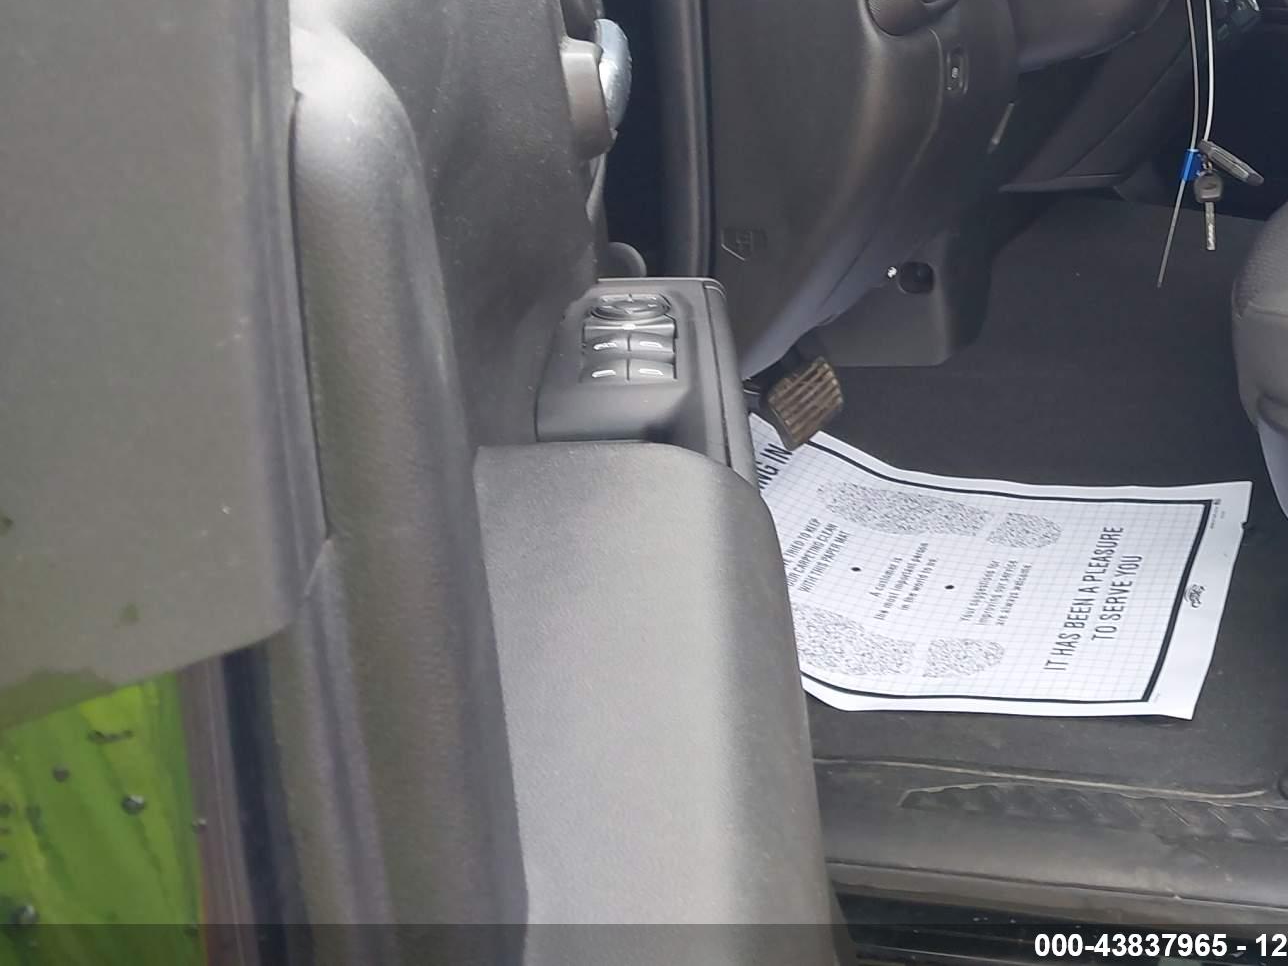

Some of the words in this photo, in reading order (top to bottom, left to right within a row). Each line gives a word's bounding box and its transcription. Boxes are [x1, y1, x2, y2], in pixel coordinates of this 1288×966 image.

[760, 443, 792, 464] IN
[798, 532, 812, 542] TO
[803, 519, 820, 533] KEEP
[784, 539, 805, 559] TRIED
[784, 572, 801, 587] OUR
[793, 541, 825, 574] CARPETING
[816, 524, 839, 543] CLEAN
[911, 543, 929, 563] person
[1082, 527, 1124, 582] PLEASURE
[798, 575, 820, 593] WITH
[811, 562, 829, 576] THIS
[820, 542, 842, 563] PAPER
[875, 563, 899, 592] customer
[888, 562, 918, 592] important
[1000, 560, 1019, 582] service
[1114, 555, 1143, 578] YOU
[903, 592, 919, 603] the
[912, 574, 929, 591] world
[1078, 586, 1100, 594] A
[883, 591, 901, 609] most
[1000, 592, 1019, 614] always
[1100, 581, 1133, 621] SERVE
[1063, 598, 1096, 629] BEEN
[1091, 625, 1117, 641] TO
[1050, 633, 1082, 656] HAS
[1044, 659, 1069, 671] IT
